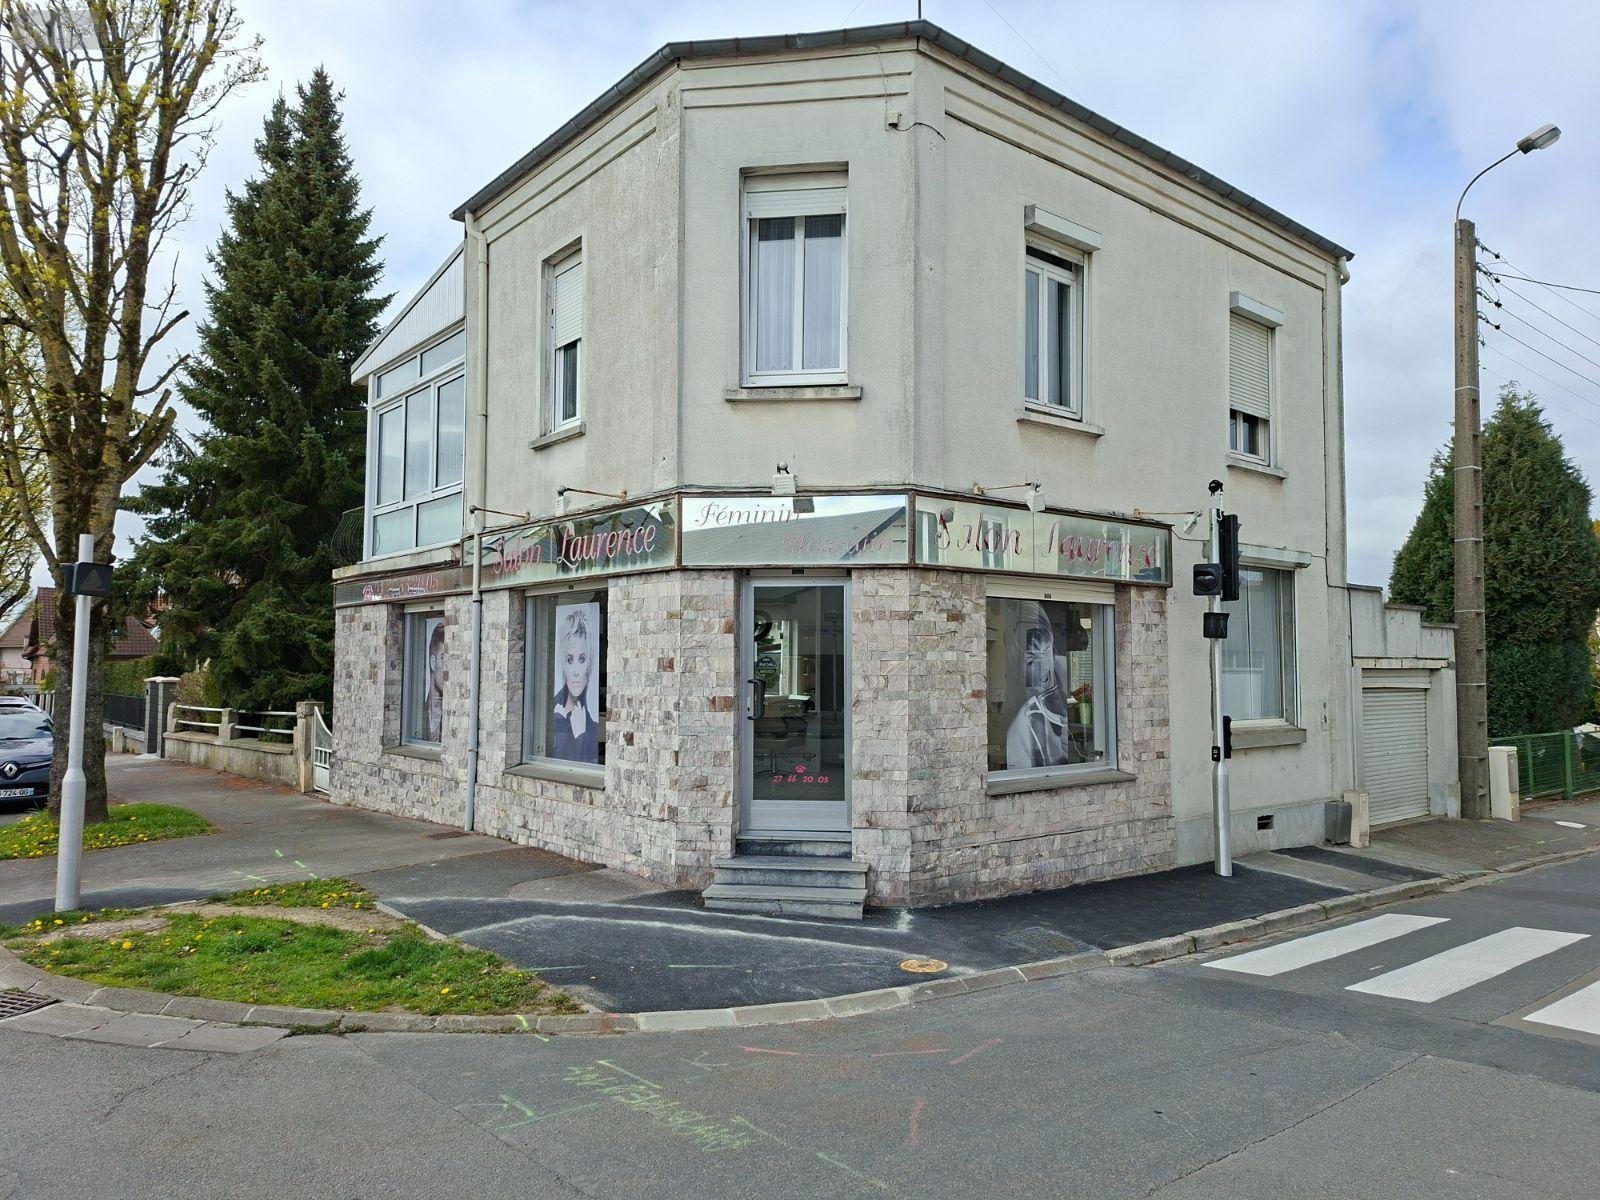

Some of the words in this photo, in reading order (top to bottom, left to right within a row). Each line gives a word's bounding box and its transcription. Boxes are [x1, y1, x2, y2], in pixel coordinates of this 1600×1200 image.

[695, 501, 801, 527] Féminin
[556, 525, 656, 568] Laurence
[787, 774, 798, 783] 66
[802, 775, 814, 783] 20
[817, 776, 829, 784] 05
